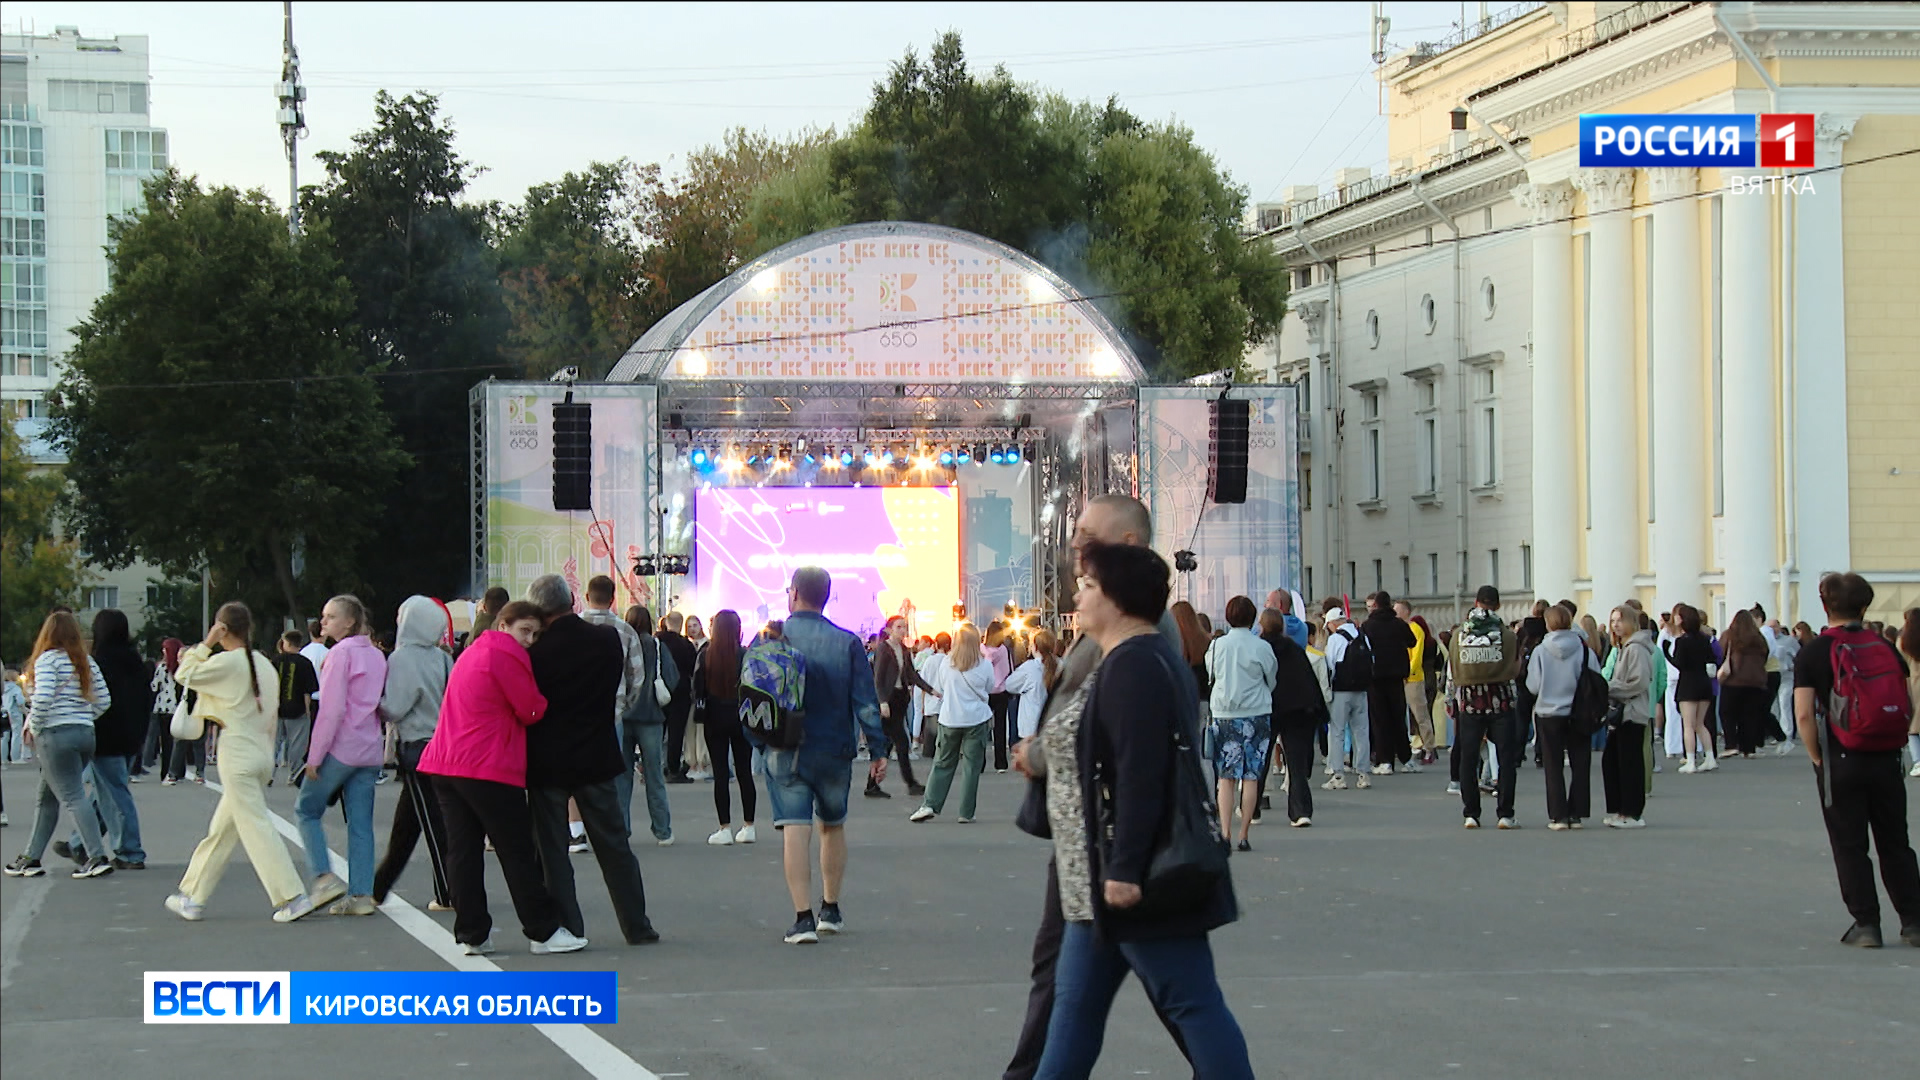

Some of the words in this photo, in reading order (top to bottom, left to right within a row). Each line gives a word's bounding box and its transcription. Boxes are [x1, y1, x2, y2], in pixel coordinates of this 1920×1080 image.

[880, 331, 918, 348] 650
[510, 437, 538, 450] 650
[1250, 437, 1276, 450] 650
